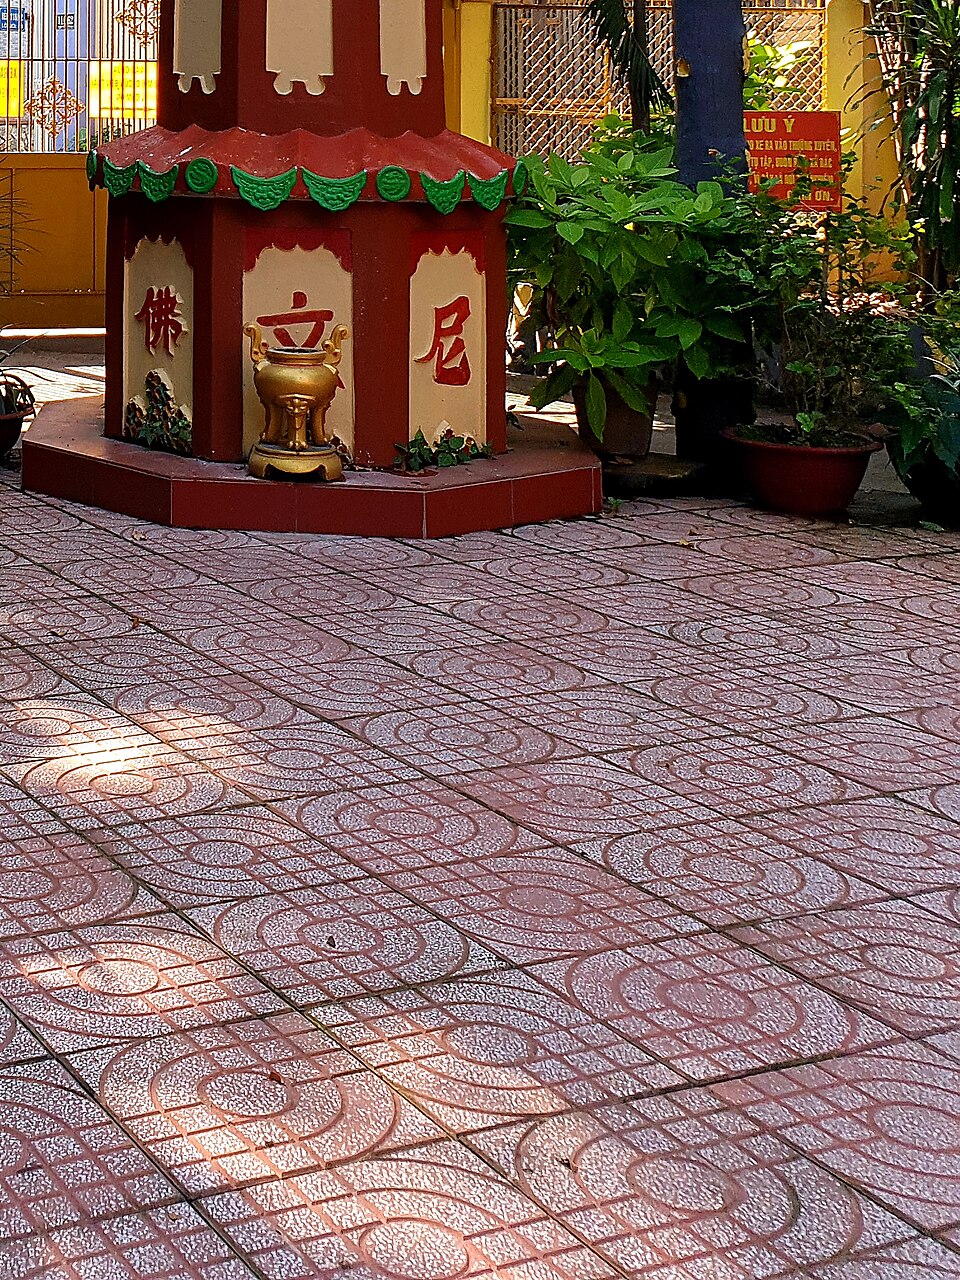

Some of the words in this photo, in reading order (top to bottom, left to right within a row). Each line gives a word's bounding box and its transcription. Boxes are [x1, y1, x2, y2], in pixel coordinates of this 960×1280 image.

[783, 115, 795, 133] Ý
[135, 284, 187, 359] 佛
[413, 295, 472, 386] 尼
